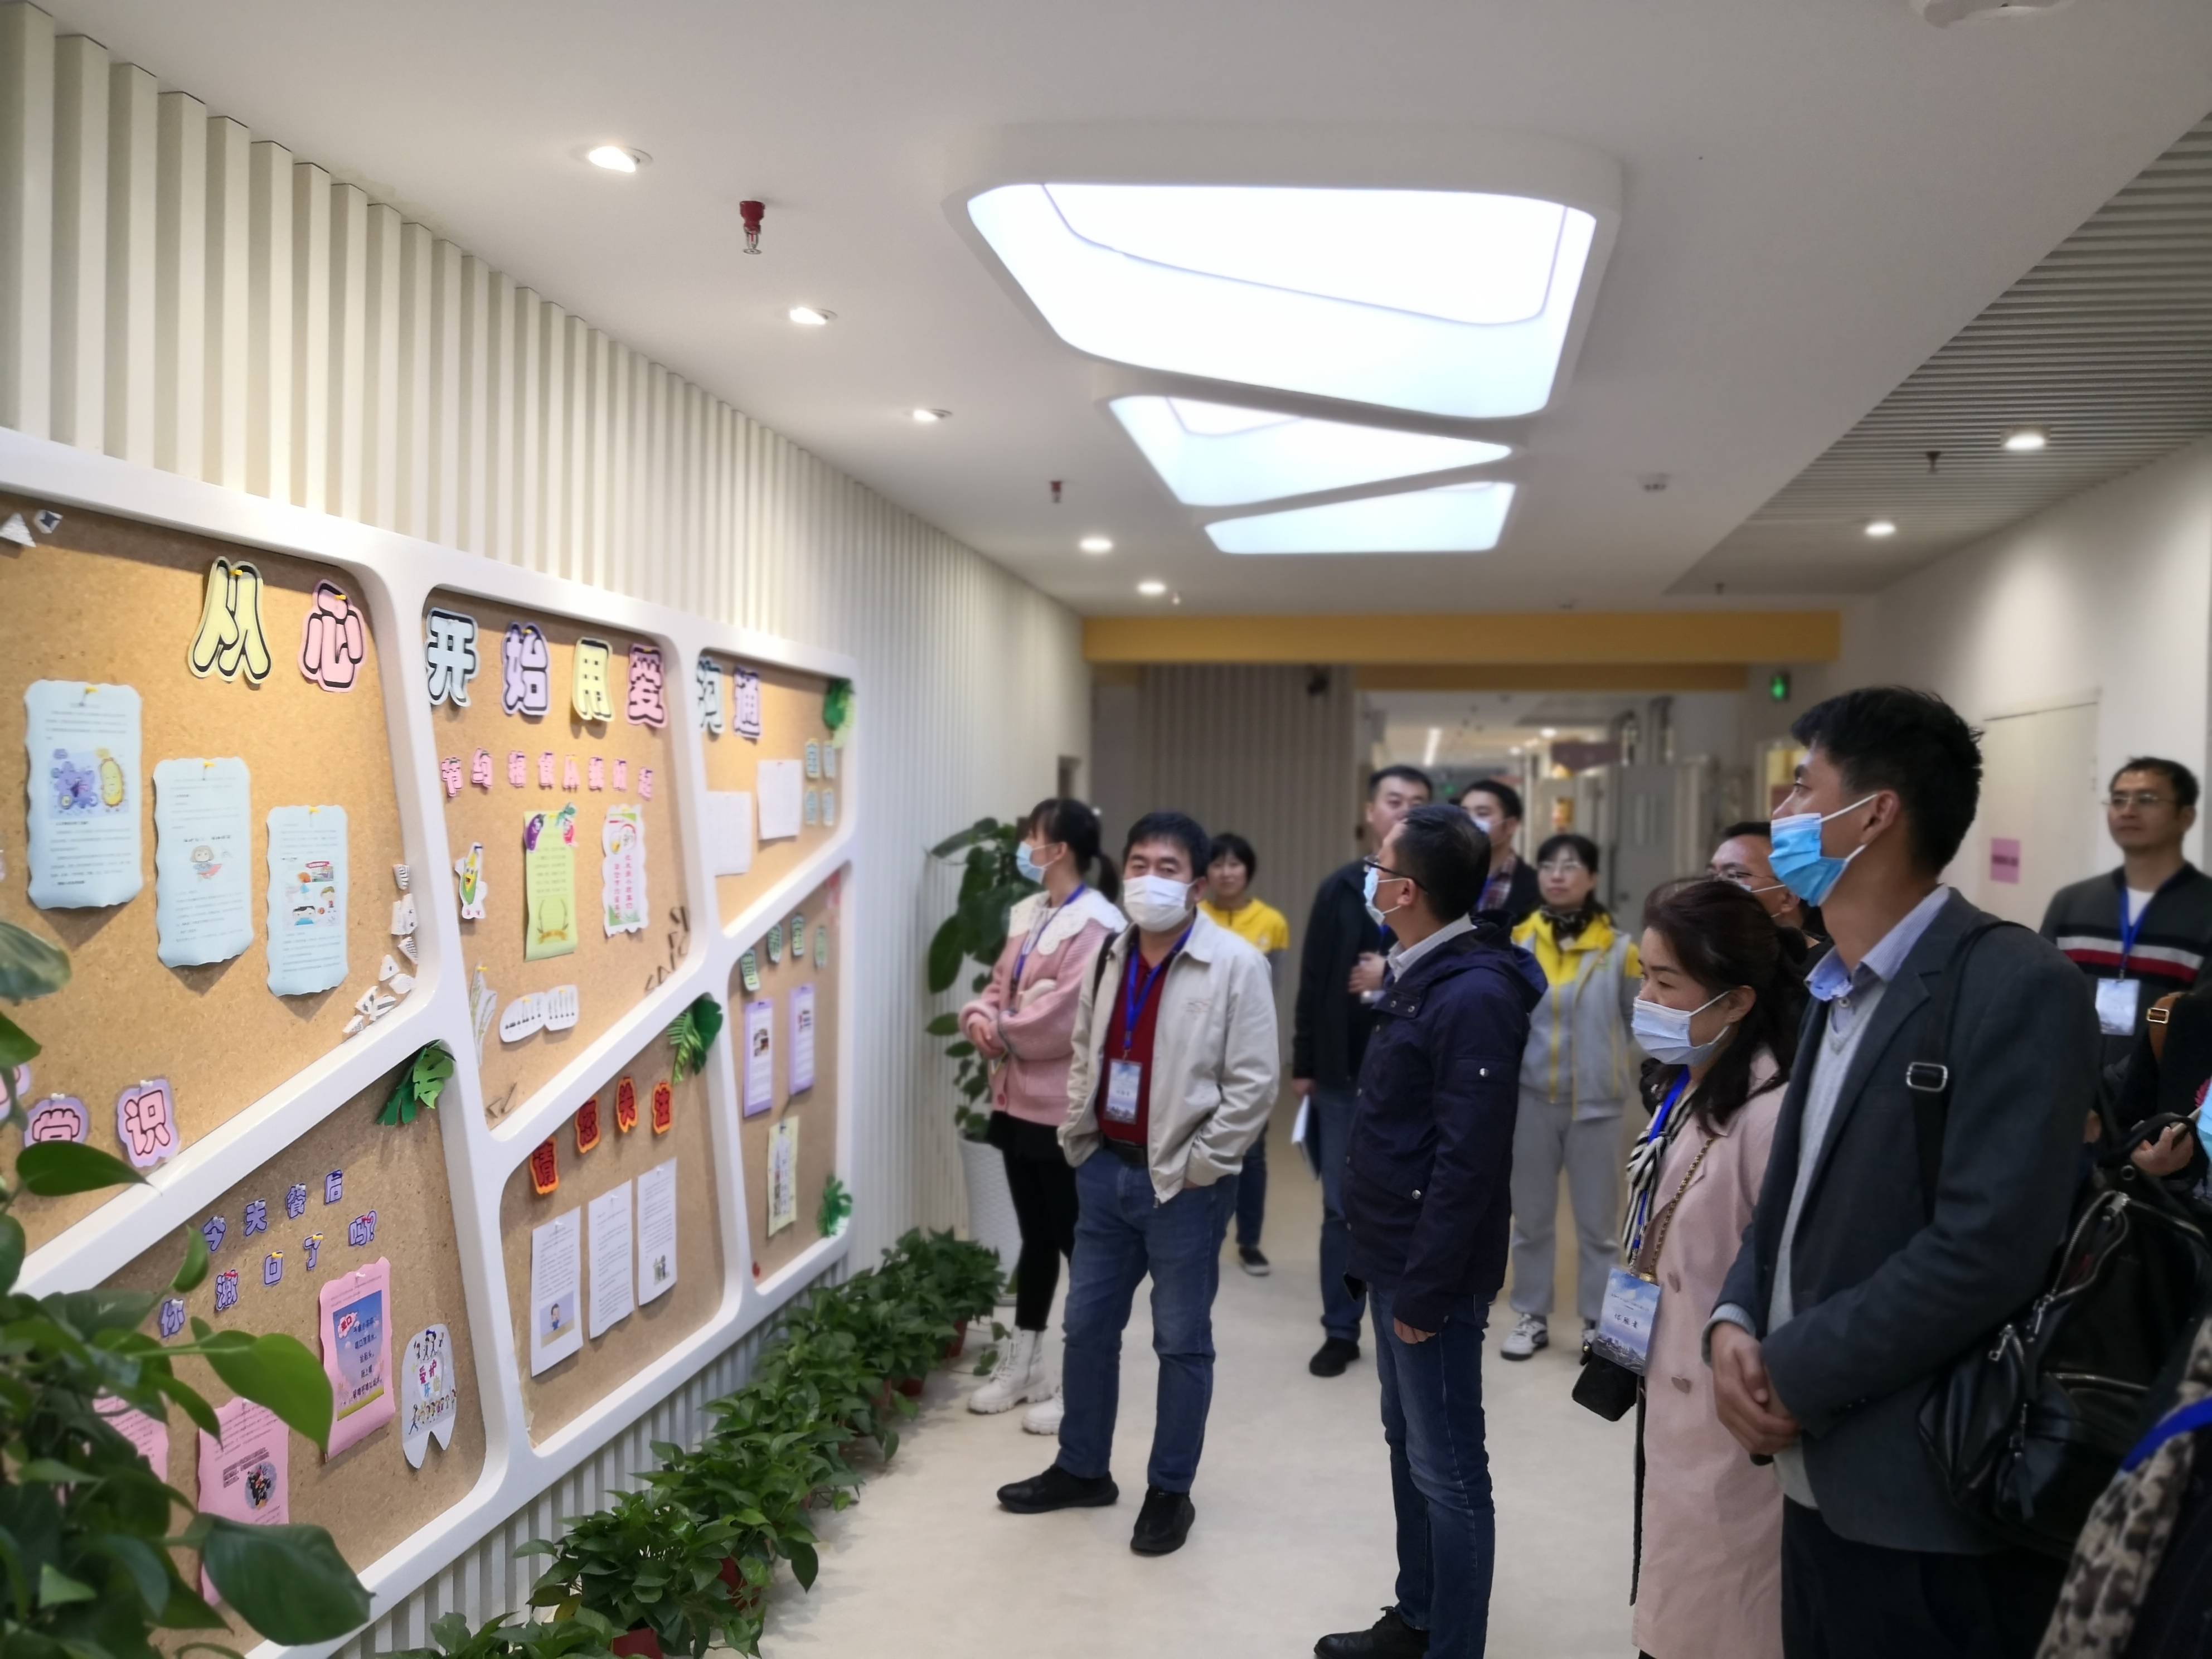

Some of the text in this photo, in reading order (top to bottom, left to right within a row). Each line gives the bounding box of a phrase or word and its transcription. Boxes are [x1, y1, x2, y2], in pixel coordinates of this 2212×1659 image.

[203, 1170, 343, 1252] 今天餐后
[161, 1211, 377, 1337] 你漱口了吗?
